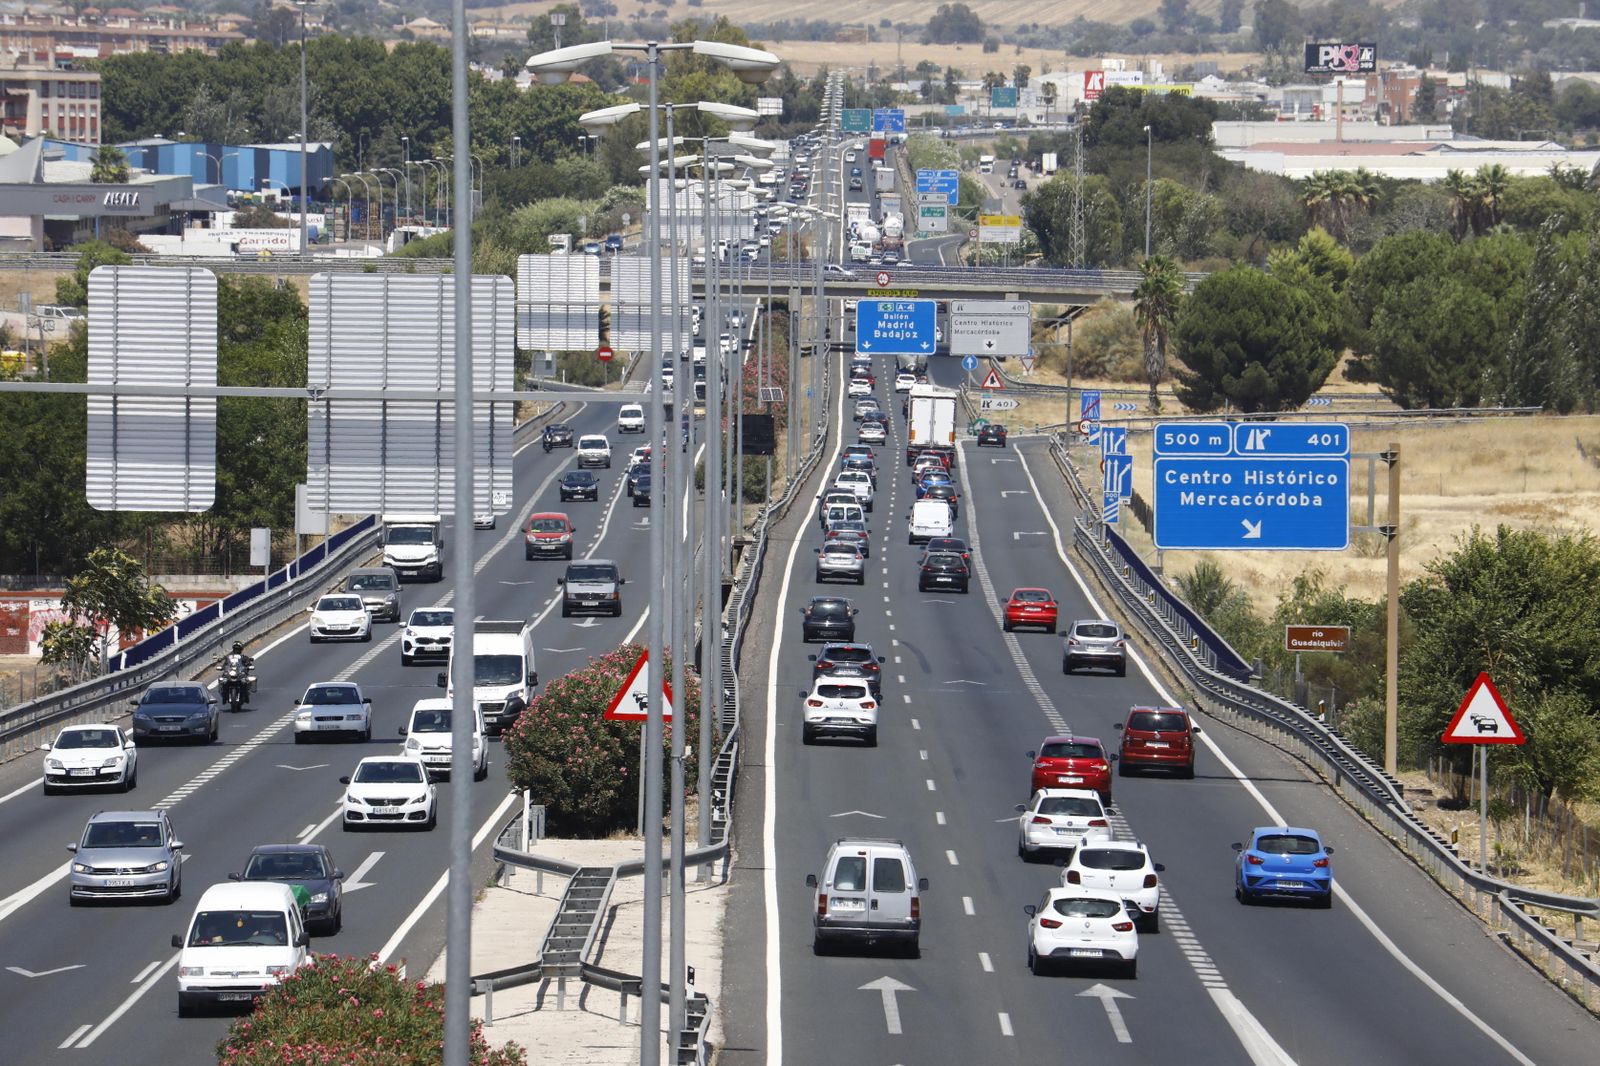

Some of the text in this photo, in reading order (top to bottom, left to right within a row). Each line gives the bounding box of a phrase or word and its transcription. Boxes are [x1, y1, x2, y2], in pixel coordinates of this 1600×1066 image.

[240, 237, 287, 245] Garrido
[878, 321, 914, 329] Madrid
[874, 330, 918, 341] Badajoz
[1164, 433, 1222, 446] 500 m
[1307, 433, 1340, 446] 401
[1165, 470, 1338, 485] Centro Histórico
[1180, 491, 1323, 506] Mercacórdoba
[1291, 638, 1345, 648] Guadalquivir
